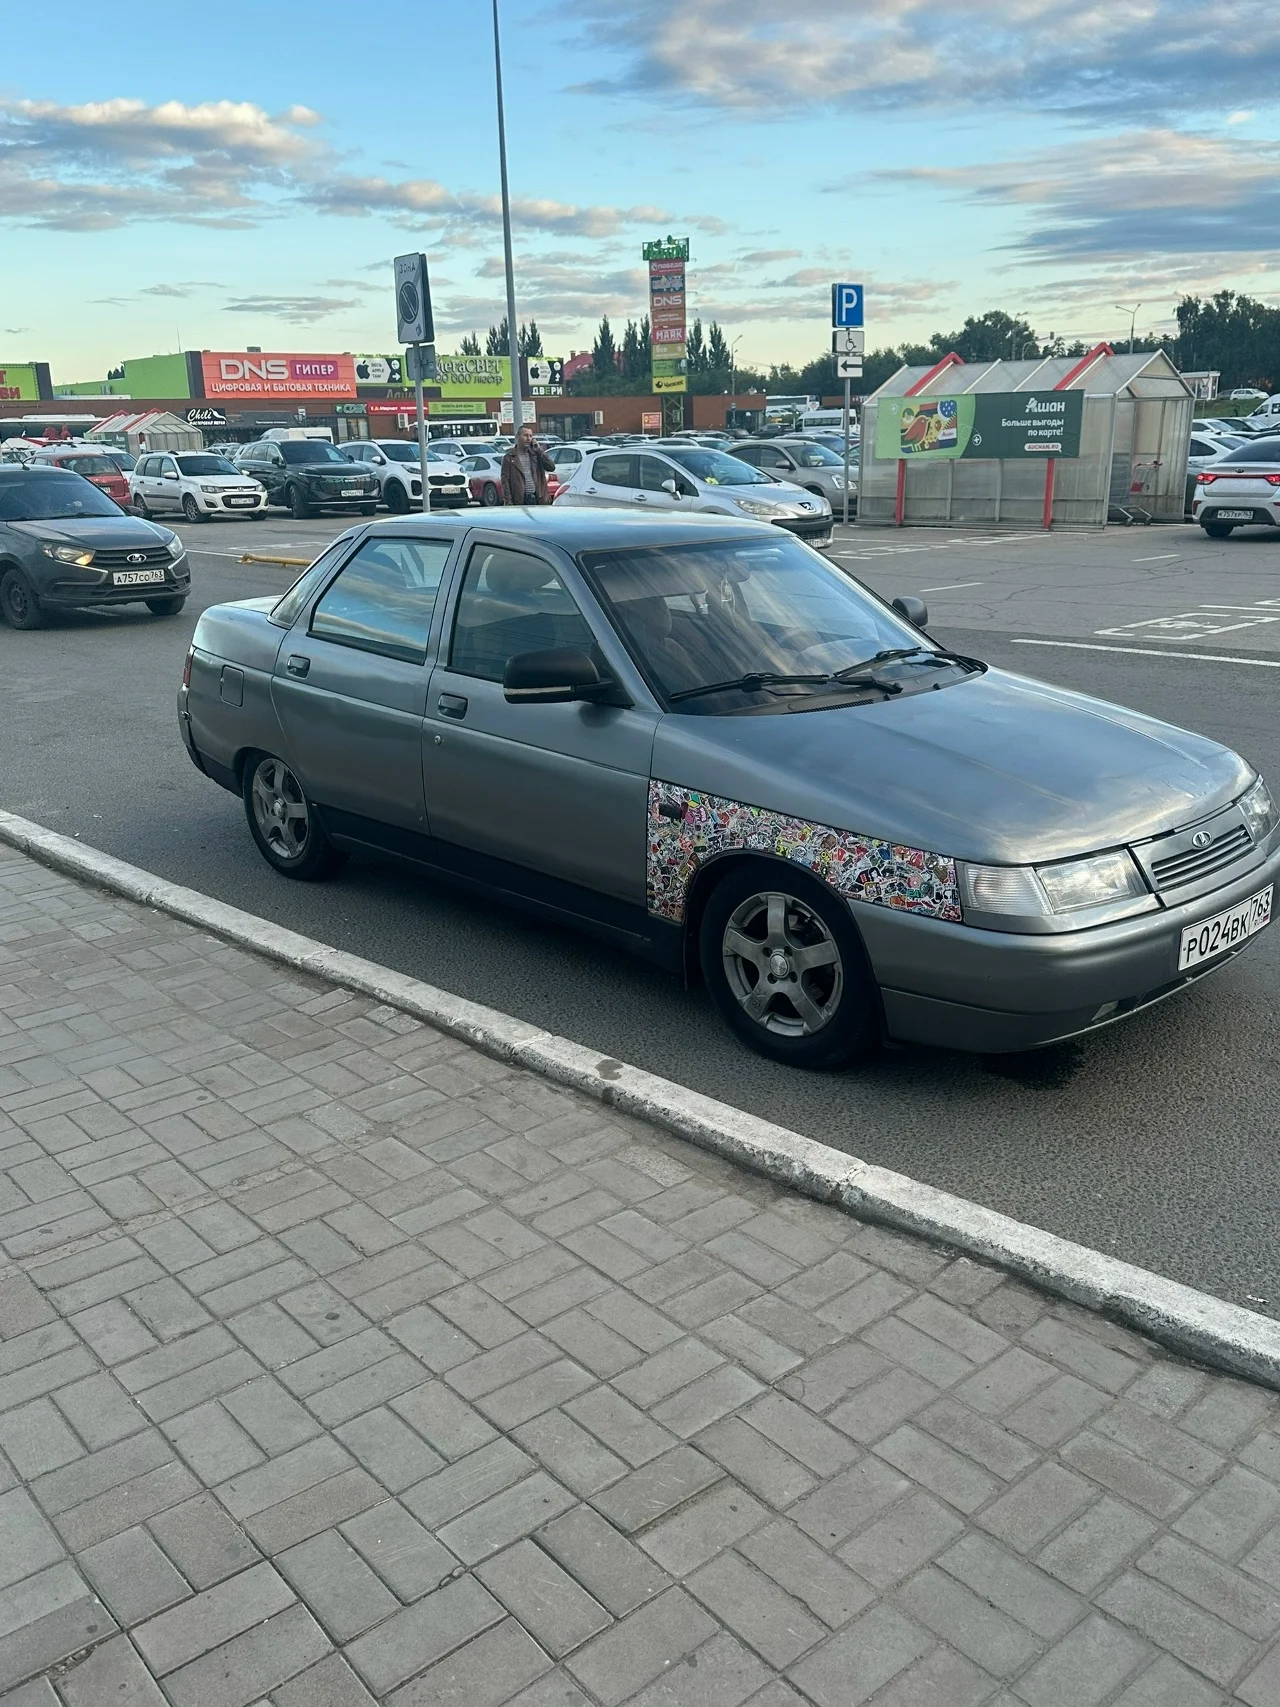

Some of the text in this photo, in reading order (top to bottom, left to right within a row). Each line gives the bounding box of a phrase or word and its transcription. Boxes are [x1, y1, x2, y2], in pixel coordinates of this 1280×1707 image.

[400, 262, 416, 273] ЗОНА
[653, 295, 682, 306] DNS
[842, 288, 857, 322] P
[656, 329, 682, 341] МАЯК
[220, 359, 335, 380] DNS ГИПЕР
[211, 383, 262, 393] ЦИФРОВАЯ
[272, 383, 313, 392] БЫТОВАЯ
[314, 383, 352, 392] ТЕХНИКА
[532, 386, 563, 395] ДВЕРИ
[1025, 397, 1065, 413] Ашан
[187, 408, 212, 422] Chili
[1001, 418, 1064, 427] Больше выгоды
[1038, 426, 1064, 438] карте!
[117, 573, 150, 584] А757СО
[1186, 891, 1271, 963] Р024ВК 763
